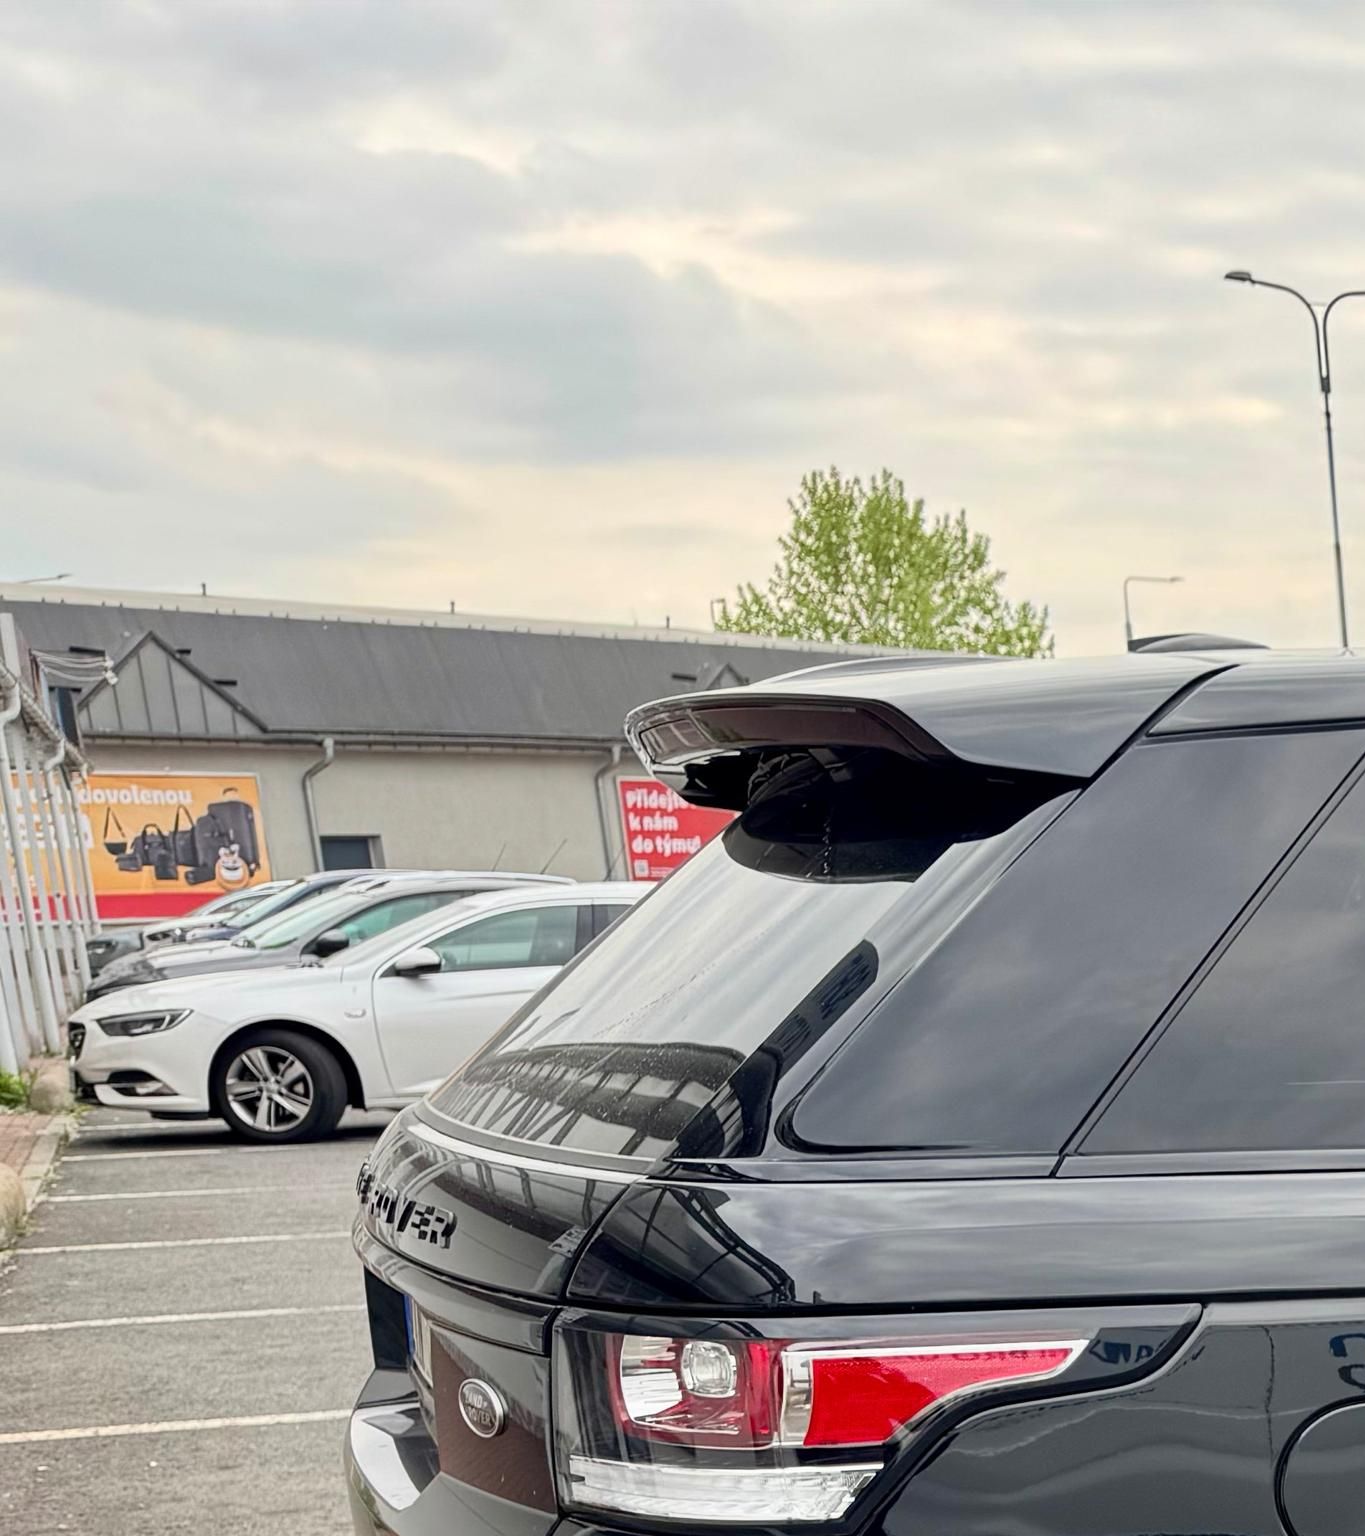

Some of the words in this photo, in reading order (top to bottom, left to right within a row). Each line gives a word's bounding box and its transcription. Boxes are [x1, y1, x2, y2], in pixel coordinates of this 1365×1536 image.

[628, 811, 641, 831] k
[642, 811, 678, 831] nám
[631, 834, 654, 854] do
